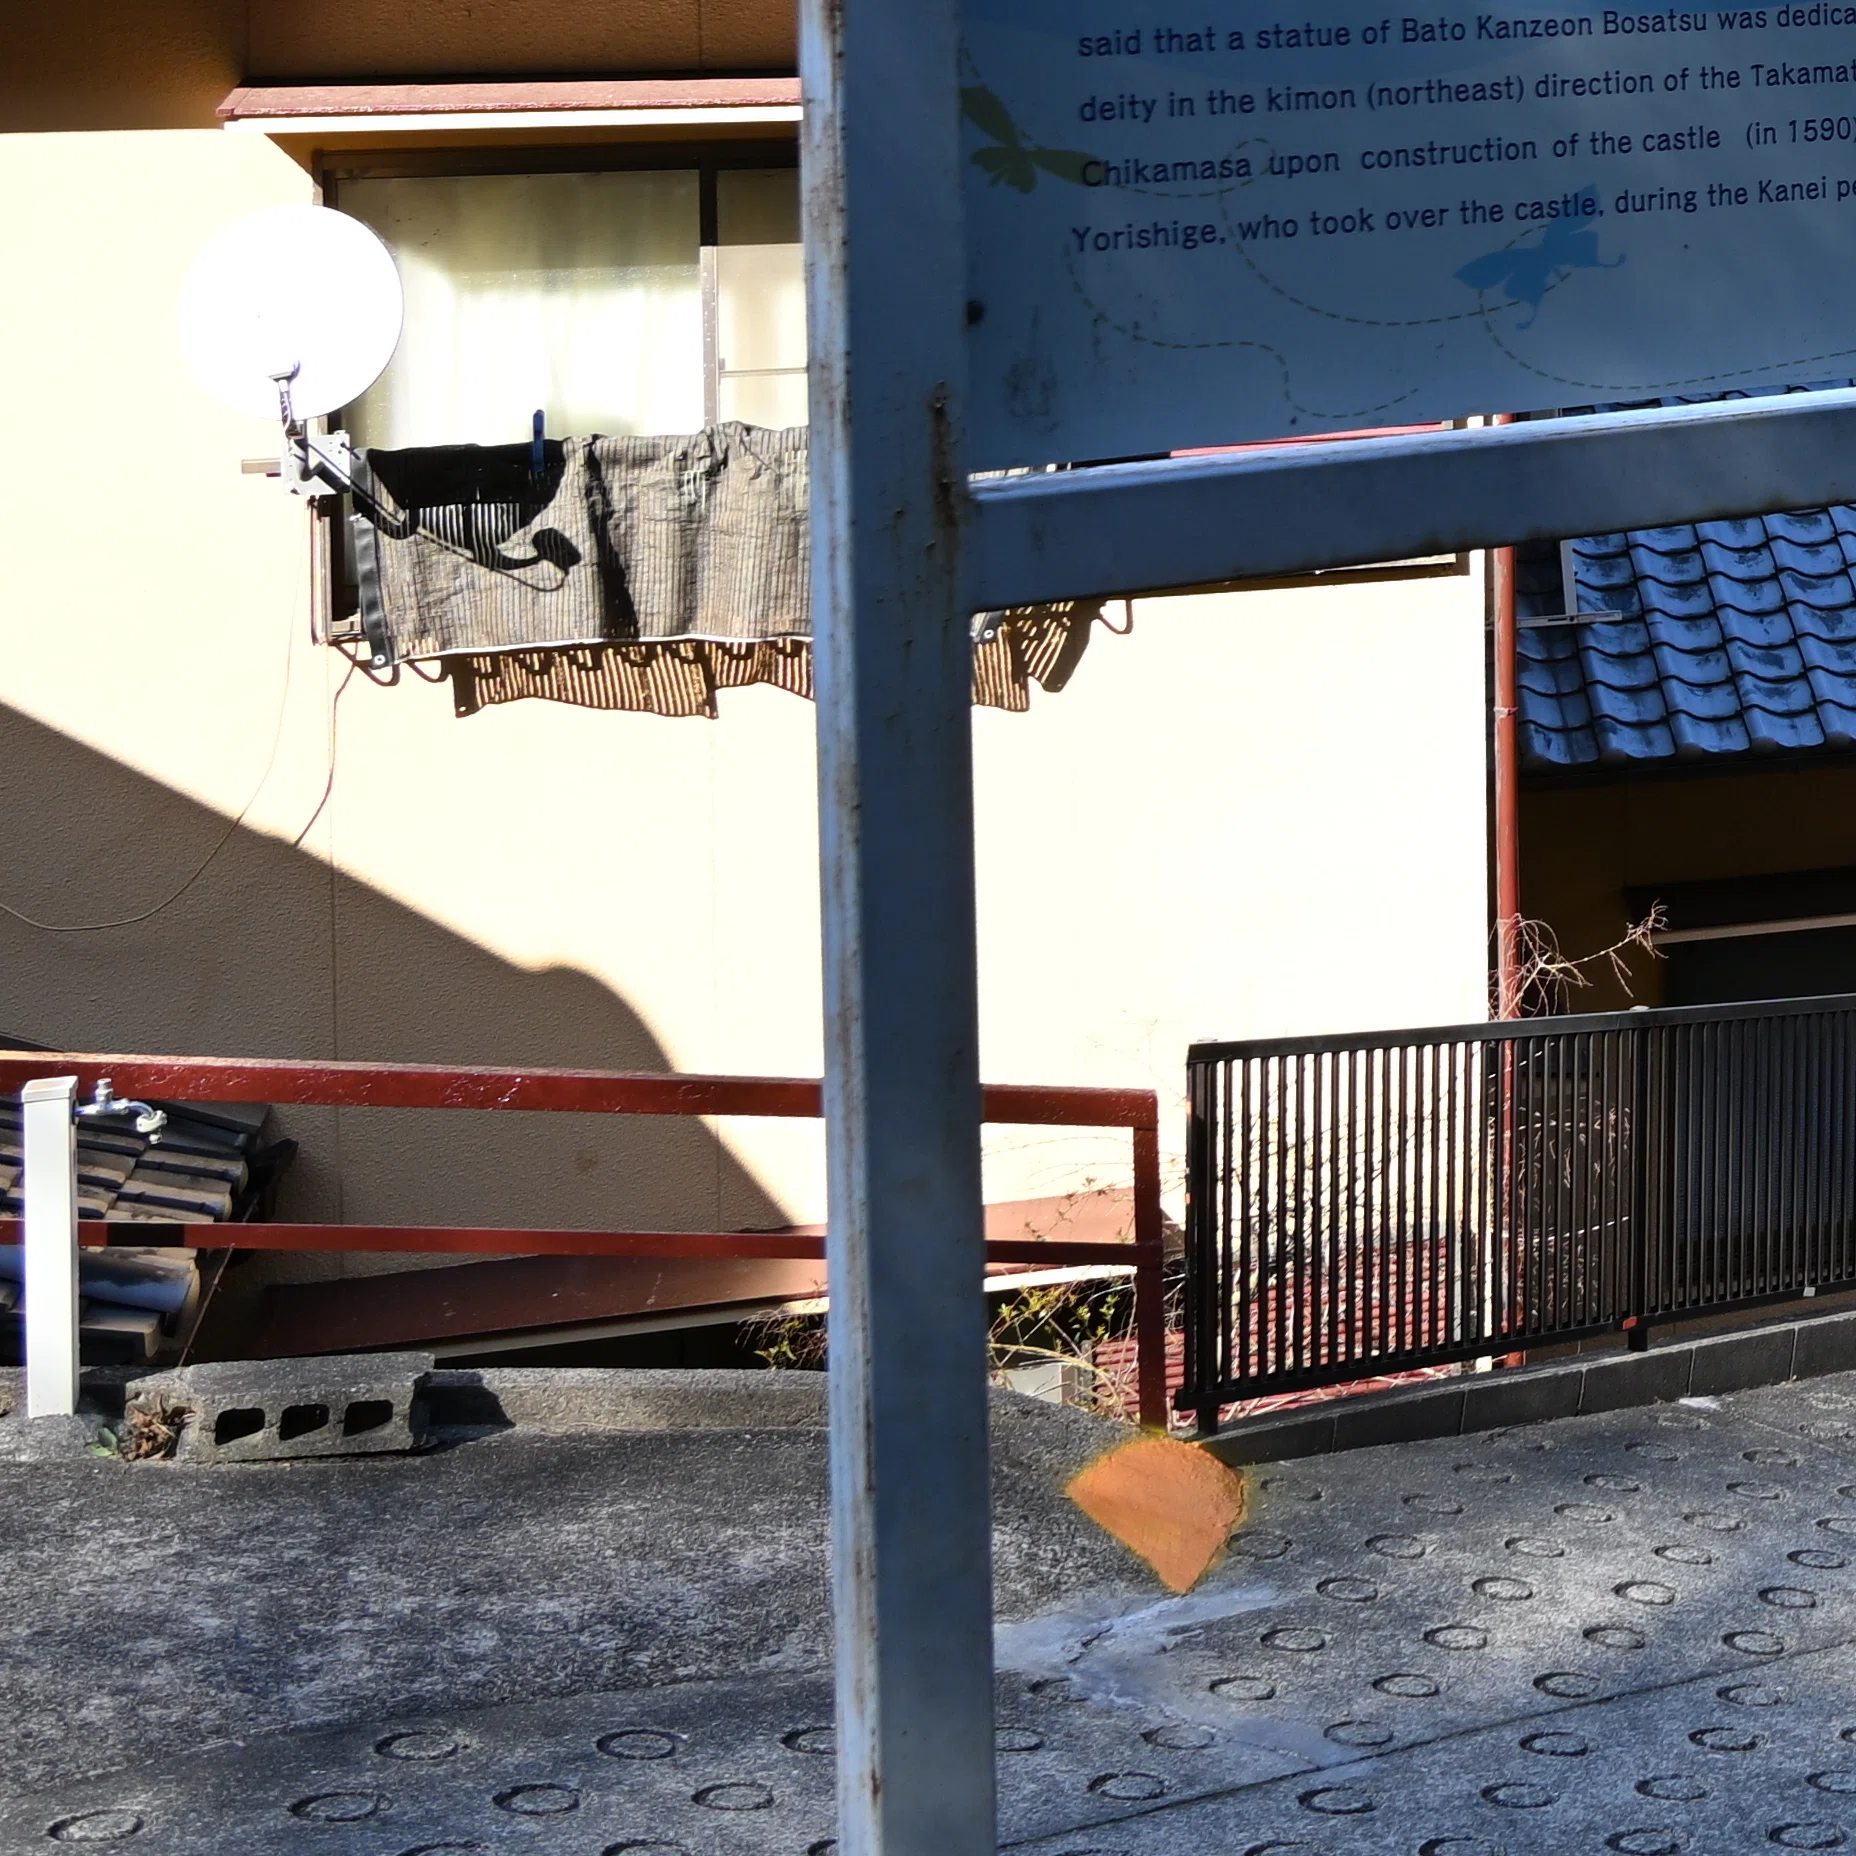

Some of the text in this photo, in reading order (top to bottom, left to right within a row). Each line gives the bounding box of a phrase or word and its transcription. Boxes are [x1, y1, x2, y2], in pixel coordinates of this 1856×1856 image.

[1077, 28, 1142, 58] said
[1152, 25, 1217, 55] that
[1226, 30, 1246, 51] a
[1255, 21, 1352, 50] statue
[1360, 18, 1392, 45] of
[1401, 16, 1466, 44] Bato
[1476, 14, 1594, 41] Kanzeon
[1602, 7, 1707, 35] Bosatsu
[1716, 10, 1768, 31] was
[1078, 93, 1158, 124] deity
[1167, 91, 1197, 118] in
[1205, 89, 1256, 116] the
[1266, 85, 1357, 113] kimon
[1366, 75, 1525, 111] (northeast)
[1534, 69, 1655, 99] direction
[1663, 66, 1690, 92] of
[1698, 65, 1741, 91] the
[1082, 149, 1253, 187] Chikamasa
[1268, 144, 1341, 184] upon
[1359, 136, 1538, 170] construction
[1552, 132, 1580, 158] of
[1588, 130, 1633, 156] the
[1642, 124, 1721, 153] castle
[1745, 121, 1778, 150] (in
[1071, 220, 1227, 253] Yorishige,
[1237, 208, 1301, 244] who
[1308, 207, 1376, 236] took
[1384, 207, 1450, 231] over
[1459, 199, 1505, 225] the
[1514, 184, 1607, 226] castle,
[1614, 186, 1698, 215] during
[1706, 182, 1749, 208] the
[1757, 175, 1827, 204] Kanei
